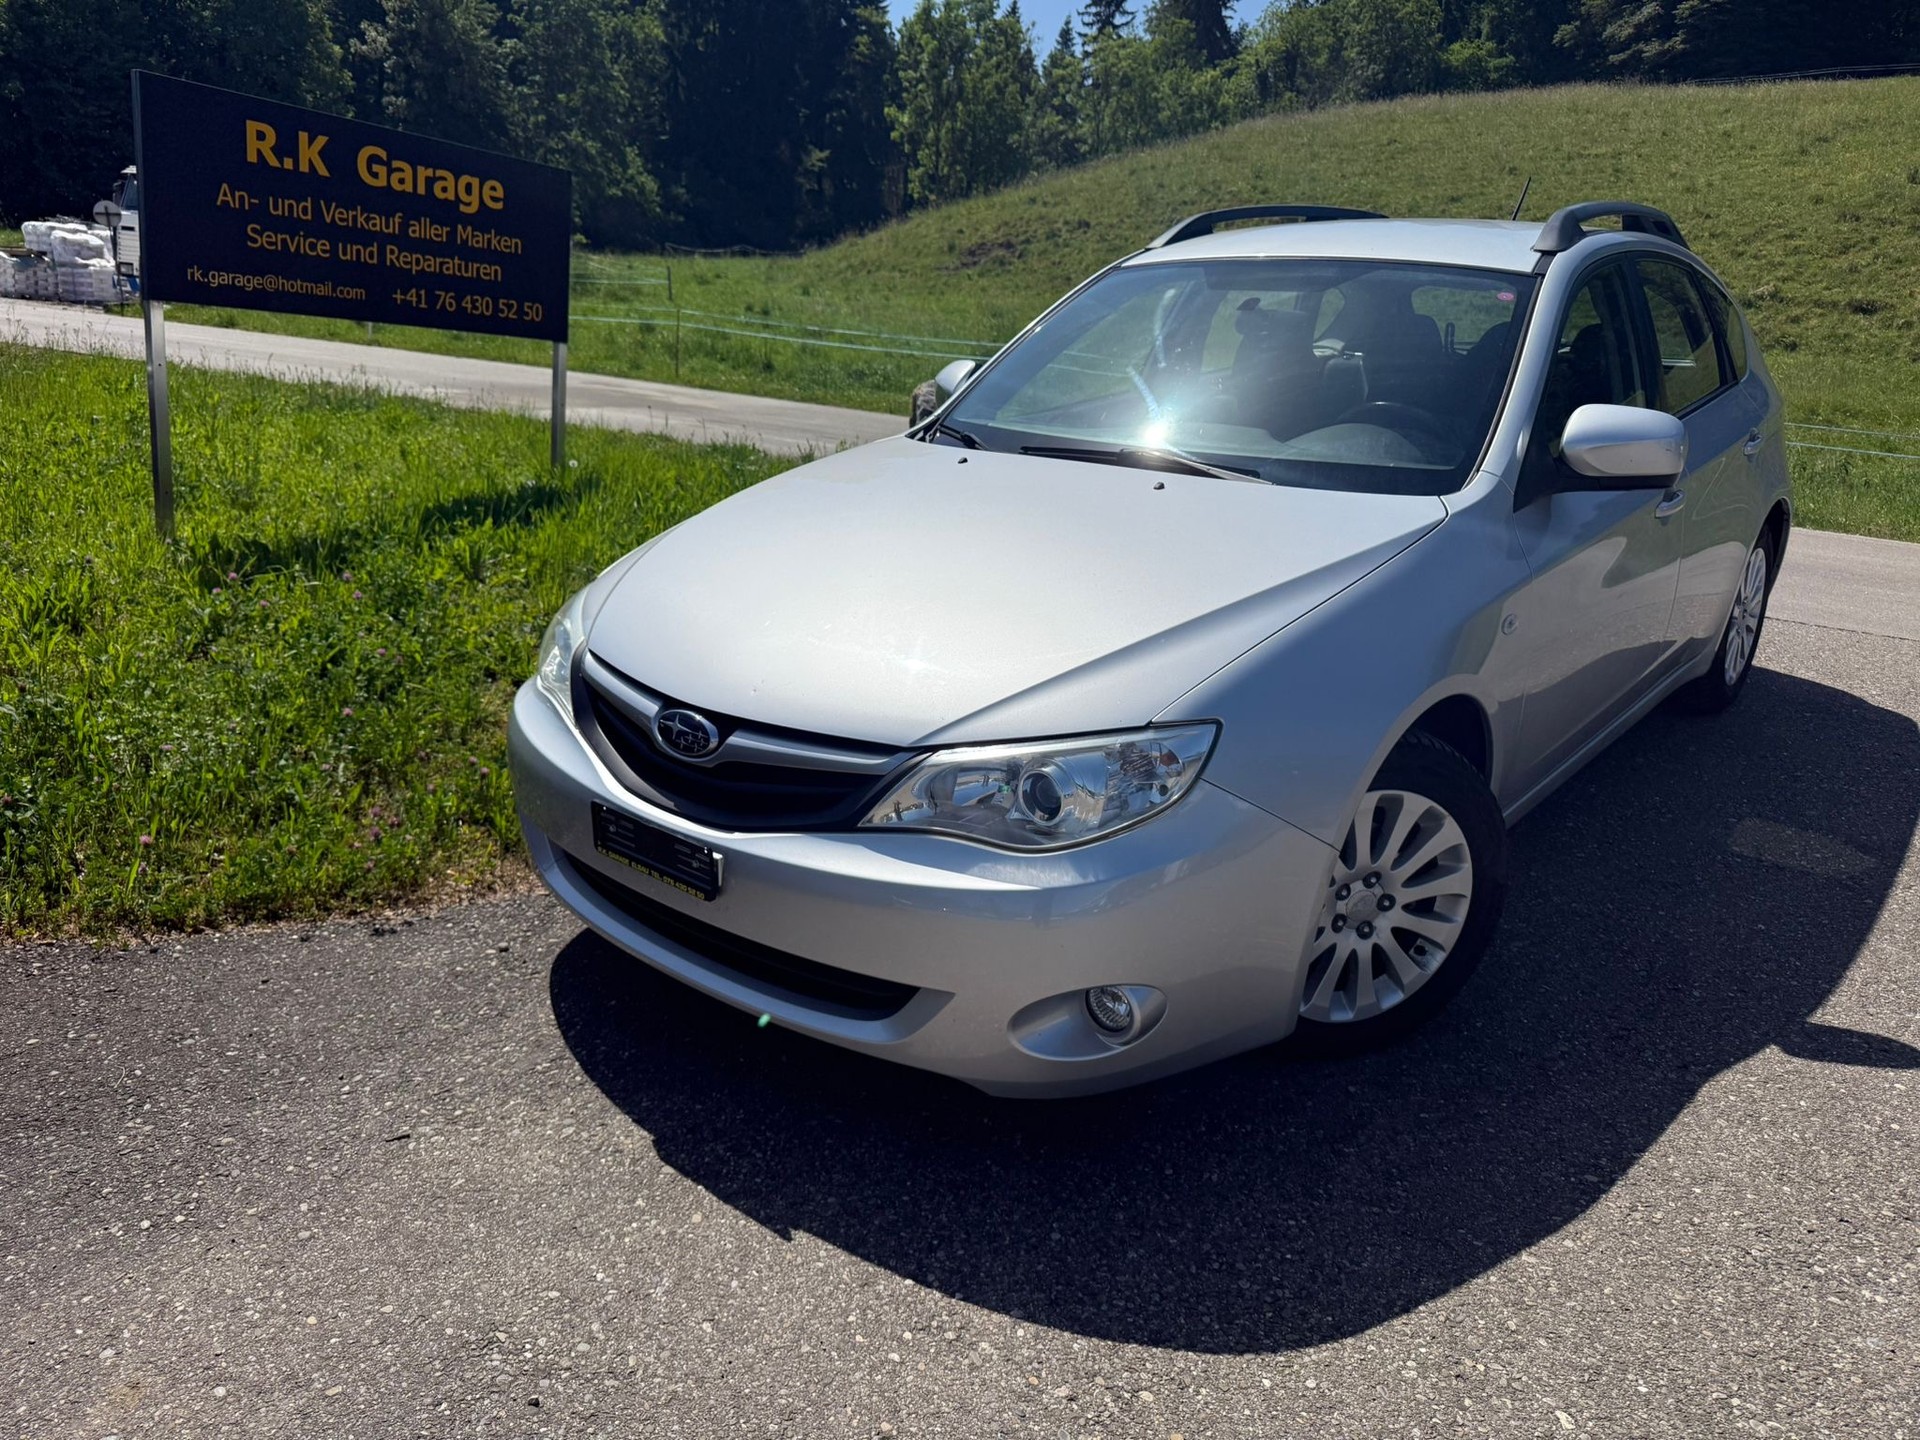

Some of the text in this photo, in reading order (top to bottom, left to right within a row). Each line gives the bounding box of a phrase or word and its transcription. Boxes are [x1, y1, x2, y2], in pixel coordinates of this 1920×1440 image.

[246, 119, 505, 214] R.K Garage
[216, 182, 522, 255] An- und Verkauf aller Marken
[246, 223, 502, 282] Service und Reparaturen
[186, 264, 366, 301] rk.garage@hotmail.com
[392, 287, 543, 322] +41 76 430 52 50
